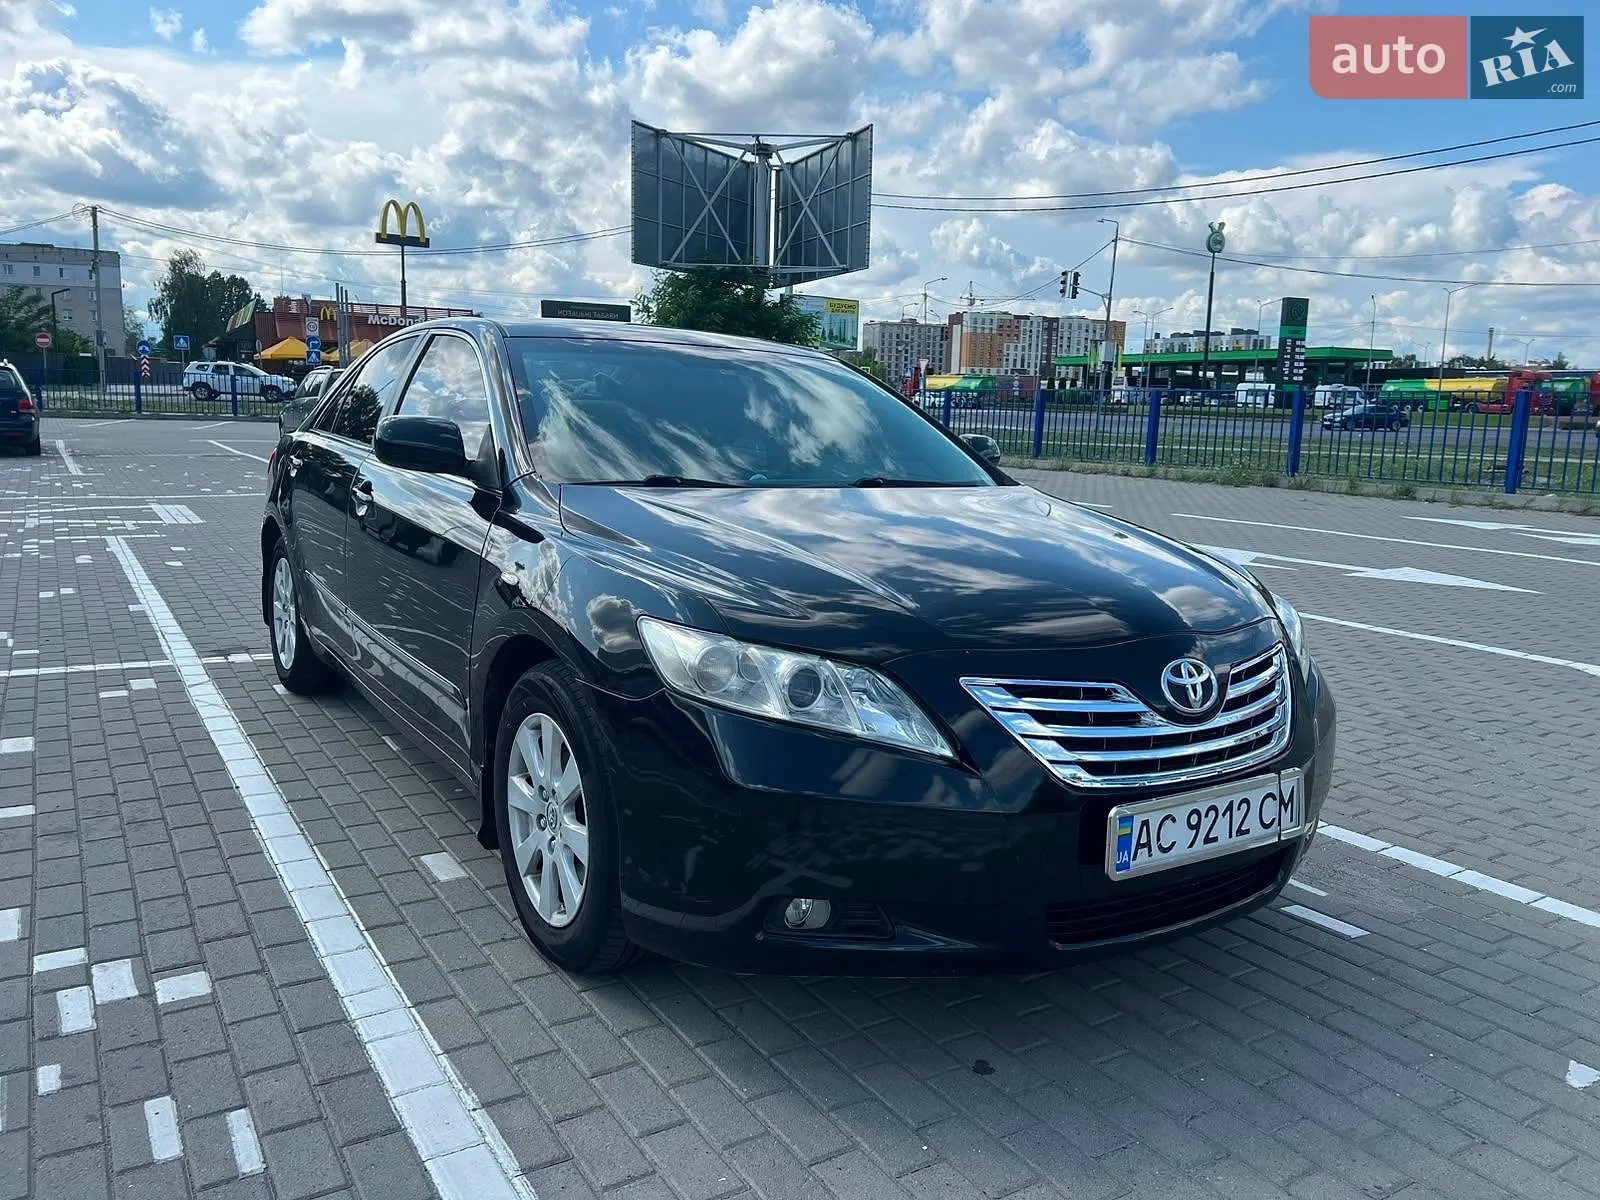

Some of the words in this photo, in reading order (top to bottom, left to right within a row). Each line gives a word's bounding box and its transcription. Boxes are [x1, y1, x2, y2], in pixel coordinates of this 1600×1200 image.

[1132, 814, 1177, 862] AC
[1186, 797, 1251, 849] 9212
[1258, 785, 1295, 830] CM
